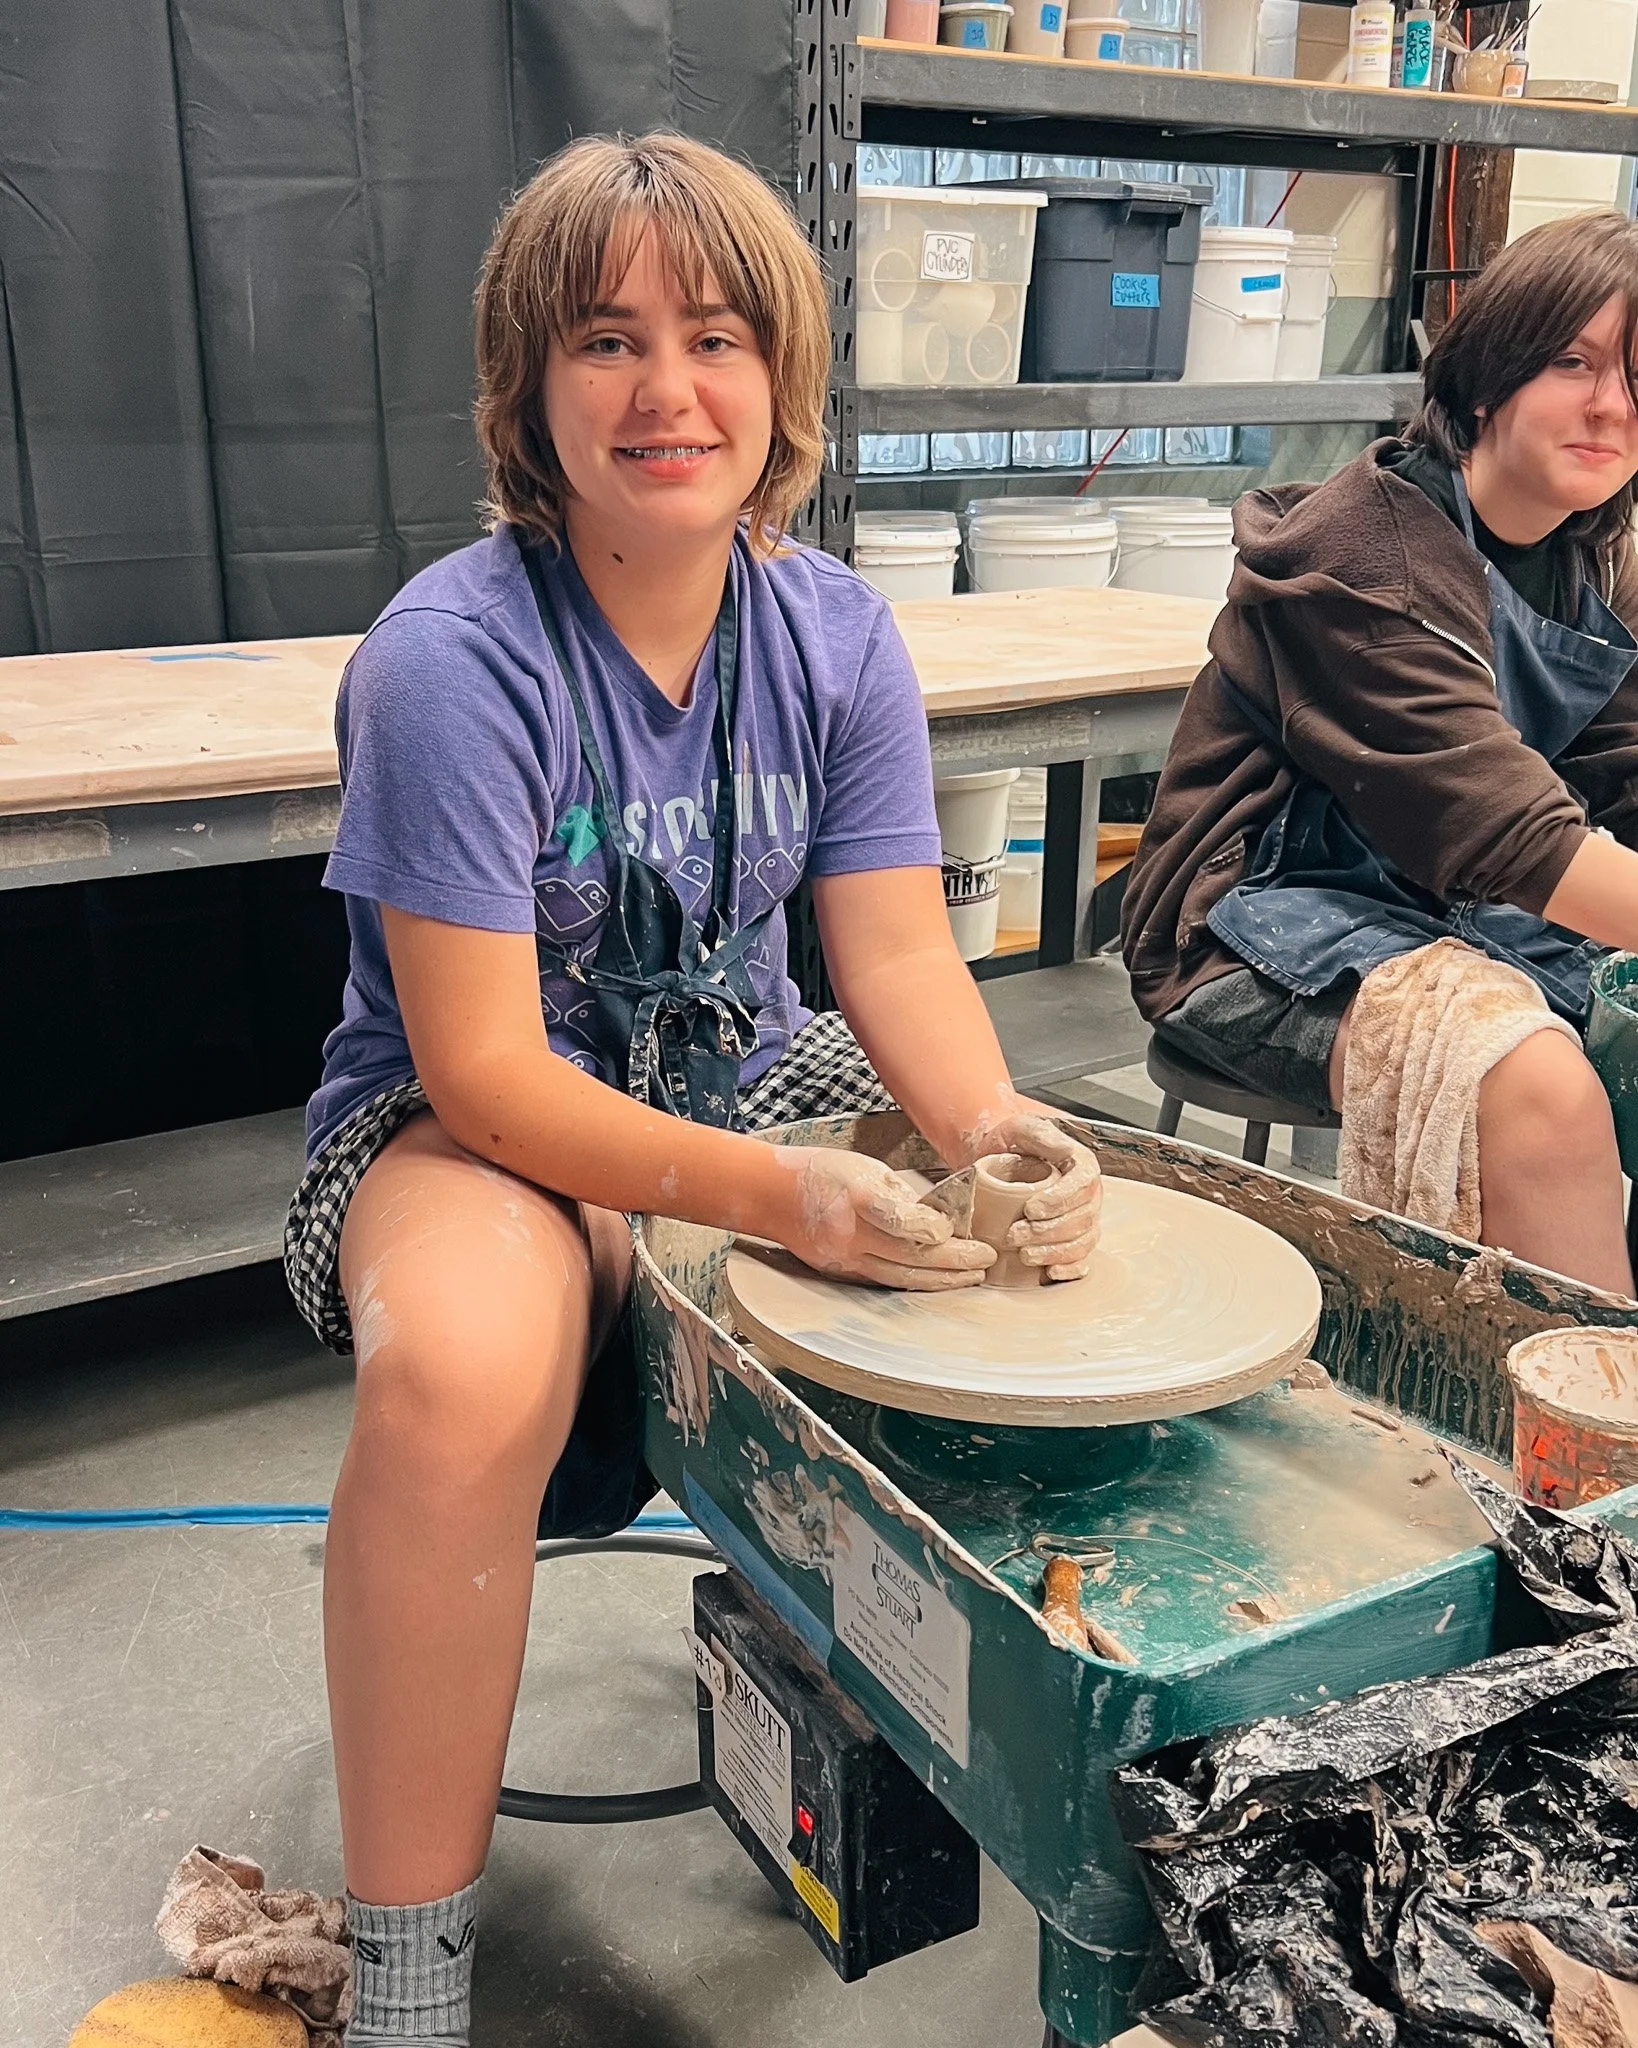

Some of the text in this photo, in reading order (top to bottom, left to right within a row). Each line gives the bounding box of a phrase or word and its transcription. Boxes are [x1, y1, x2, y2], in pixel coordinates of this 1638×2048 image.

[873, 1541, 921, 1602] THOMAS
[876, 1586, 917, 1639] STUART
[735, 1673, 785, 1752] SKUTT
[844, 1625, 852, 1643] Do
[853, 1636, 863, 1655] Not
[865, 1649, 877, 1670] Wet
[879, 1663, 908, 1702] Electrical
[910, 1695, 953, 1751] Components
[850, 1619, 867, 1645] Avoid
[869, 1638, 882, 1661] Risk
[884, 1654, 891, 1670] of
[892, 1662, 923, 1703] Electrical
[925, 1696, 945, 1727] Shock
